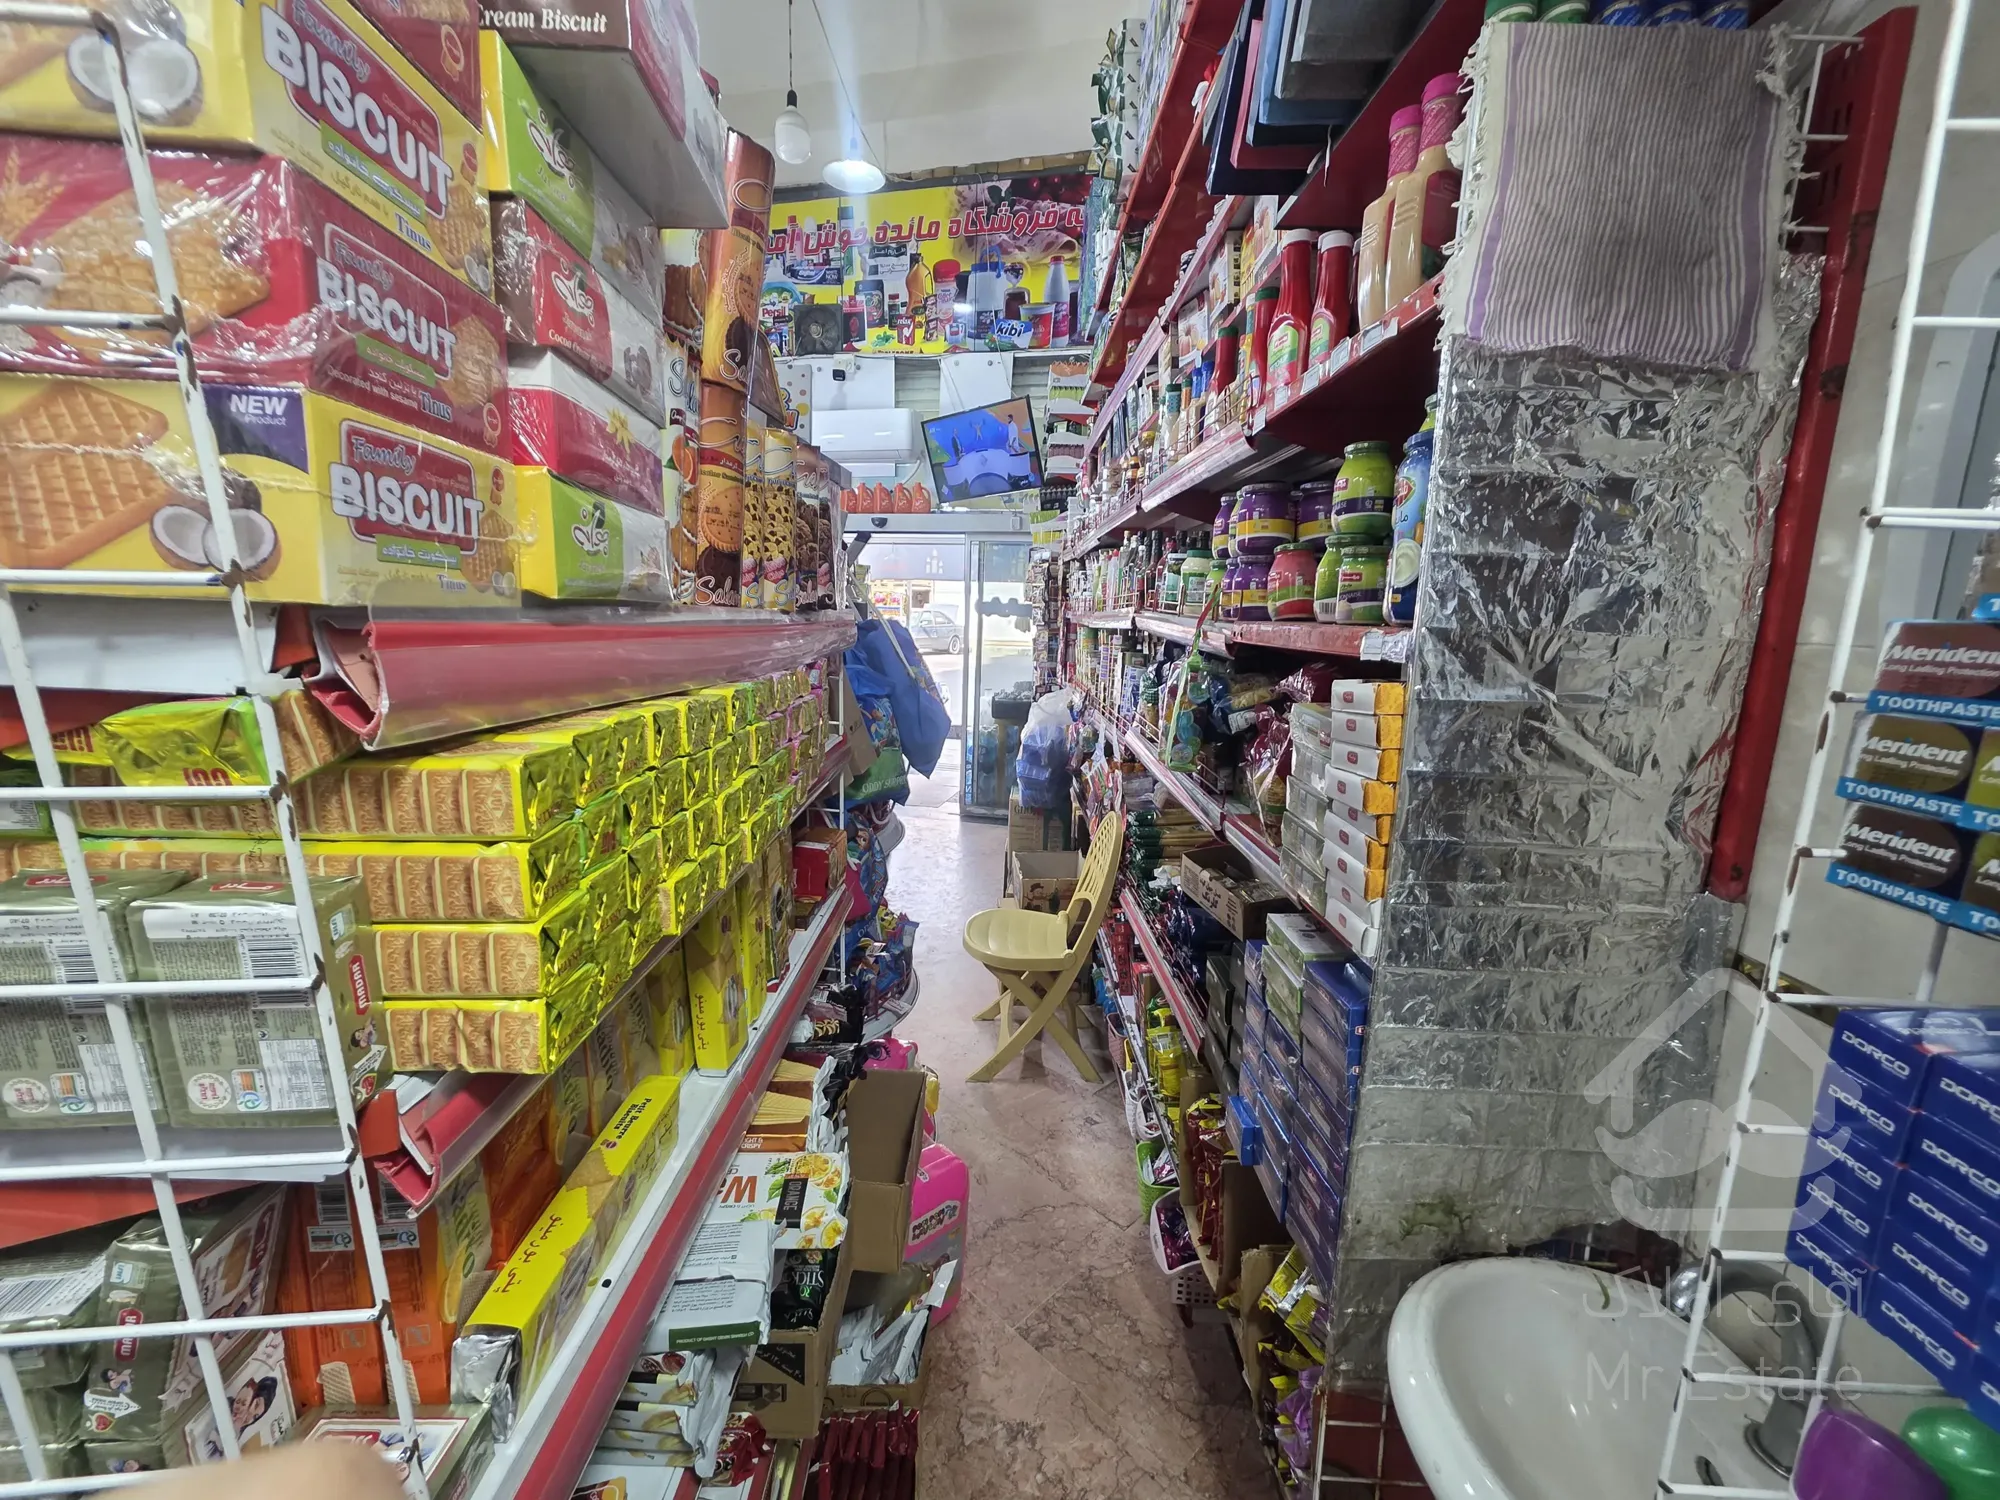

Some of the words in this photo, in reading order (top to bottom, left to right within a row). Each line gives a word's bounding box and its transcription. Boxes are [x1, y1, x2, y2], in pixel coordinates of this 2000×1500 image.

[541, 8, 608, 33] Biscuit
[260, 4, 452, 208] BISCUIT
[395, 211, 432, 252] Tinus
[804, 218, 867, 256] خوش
[874, 215, 941, 245] مائده
[947, 201, 1058, 237] فروشگاه
[316, 257, 457, 369] BISCUIT
[762, 307, 787, 318] Persil
[896, 317, 912, 326] relax
[996, 321, 1024, 338] kibi
[548, 329, 572, 348] Cocoa
[230, 394, 288, 416] NEW
[372, 384, 389, 398] with
[419, 391, 453, 422] Tinus
[244, 414, 287, 426] Product
[352, 436, 416, 476] Family
[329, 462, 485, 540] BISCUIT
[436, 573, 468, 591] Tinus
[1877, 694, 2000, 719] TOOTHPASTE
[1845, 782, 1963, 818] TOOTHPASTE
[1844, 823, 1956, 863] Merident
[1899, 854, 1948, 874] Protection
[1836, 868, 1951, 915] TOOTHPASTE
[351, 961, 371, 1011] MADAR
[1841, 1030, 1911, 1079] DORCO
[613, 1103, 640, 1130] Biscuits
[635, 1097, 653, 1117] Petit
[1828, 1084, 1896, 1135] DORCO
[1939, 1077, 2000, 1123] DORC
[615, 1114, 640, 1141] Beurre
[1817, 1136, 1882, 1189] DORCO
[1921, 1138, 2000, 1201] DORCO
[783, 1180, 802, 1211] ORANGE
[1806, 1182, 1870, 1237] DORCO
[1907, 1192, 1989, 1256] DORCO
[1796, 1232, 1859, 1289] DORCO
[1892, 1243, 1970, 1309] DORCO
[793, 1270, 825, 1288] STICK
[1881, 1300, 1956, 1370] DORCO
